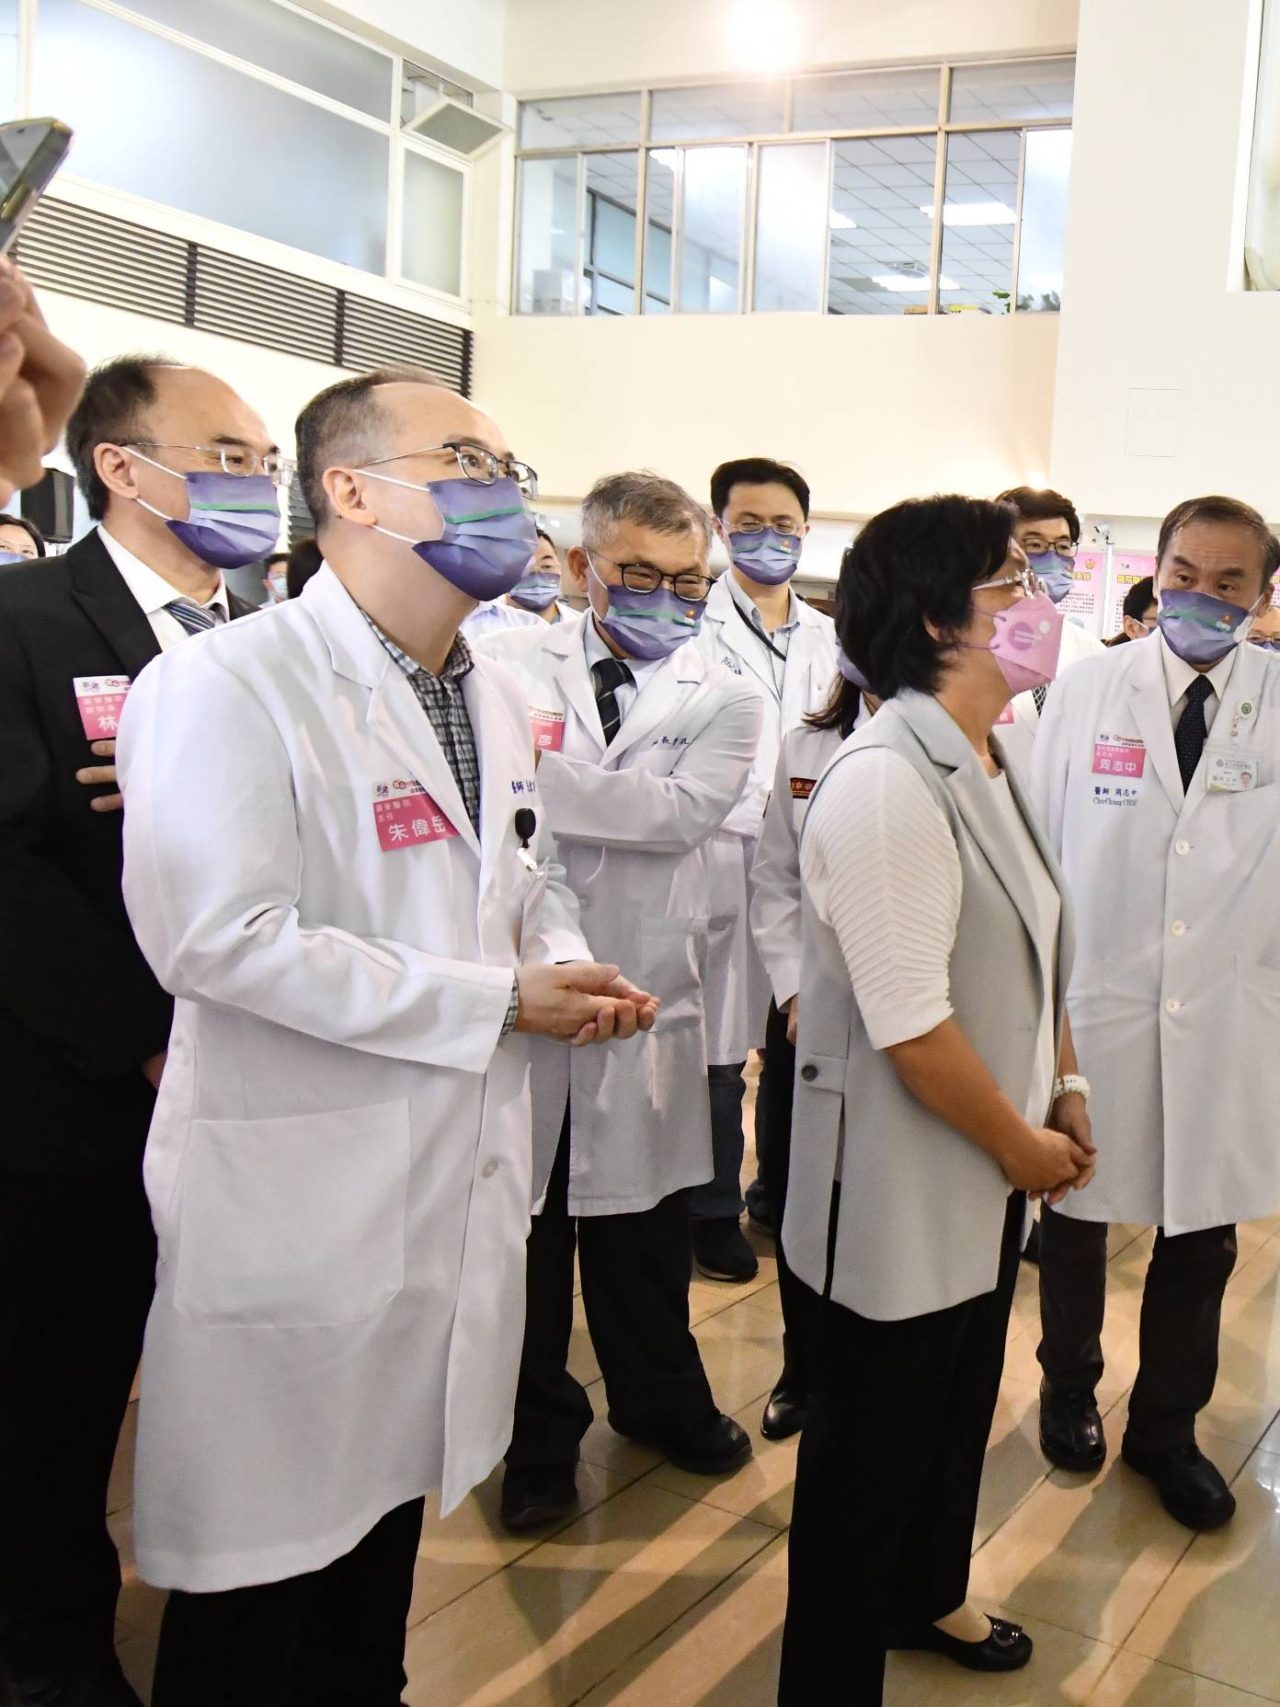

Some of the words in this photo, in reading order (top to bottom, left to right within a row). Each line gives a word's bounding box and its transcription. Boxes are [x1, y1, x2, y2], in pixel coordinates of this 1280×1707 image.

[1100, 758, 1137, 773] 周志中
[388, 815, 447, 842] 朱偉岳
